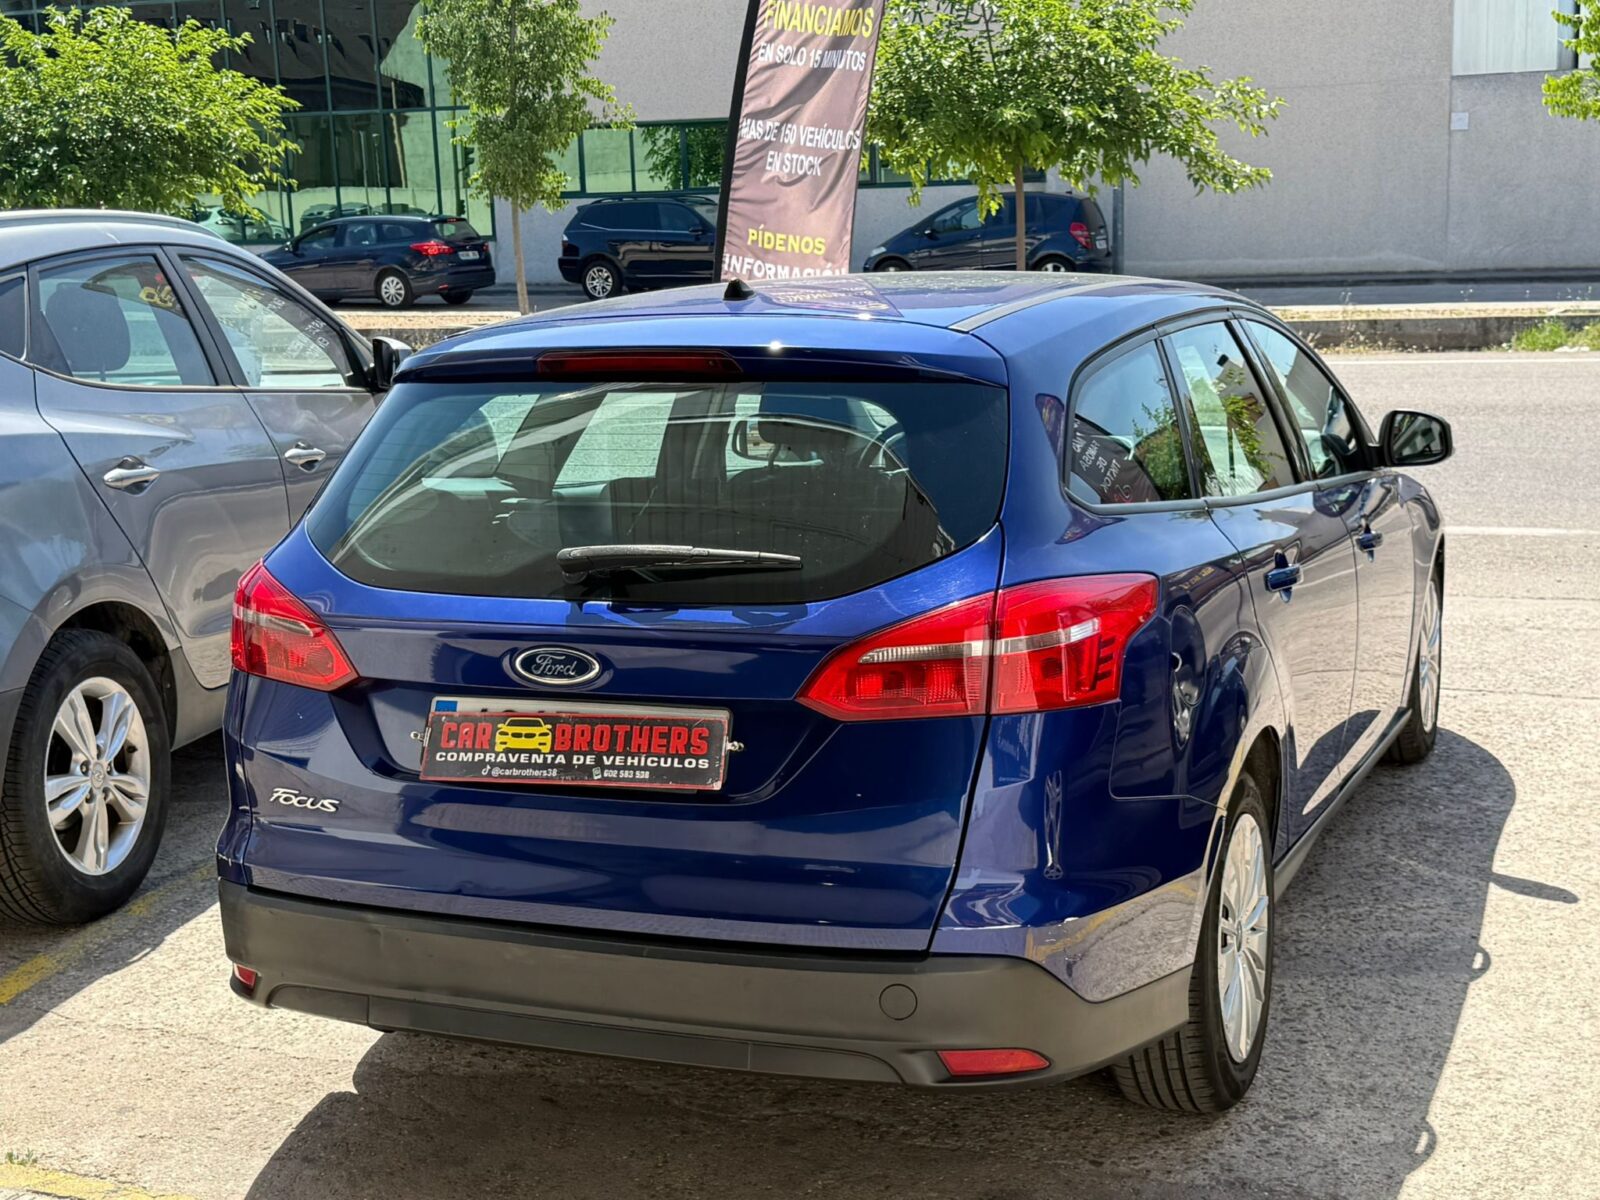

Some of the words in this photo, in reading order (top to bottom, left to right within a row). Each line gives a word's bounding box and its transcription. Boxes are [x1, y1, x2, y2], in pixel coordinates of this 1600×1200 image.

[764, 0, 875, 38] FINANCIAMOS
[758, 43, 774, 62] EN
[775, 44, 807, 67] SOLO
[809, 48, 822, 69] 15
[821, 50, 867, 71] MINUTOS
[738, 117, 764, 140] MAS
[764, 120, 781, 142] DE
[780, 122, 797, 145] 150
[800, 122, 861, 150] VEHÍCULOS
[766, 150, 783, 172] EN
[782, 152, 823, 176] STOCK
[747, 224, 826, 256] PÍDENOS
[531, 653, 578, 676] Ford
[440, 722, 493, 749] CAR
[554, 723, 710, 755] BROTHERS
[435, 751, 566, 765] COMPRAVENTA
[572, 755, 596, 765] DE
[602, 754, 710, 769] VEHÍCULOS
[491, 766, 558, 777] @carbrothers38
